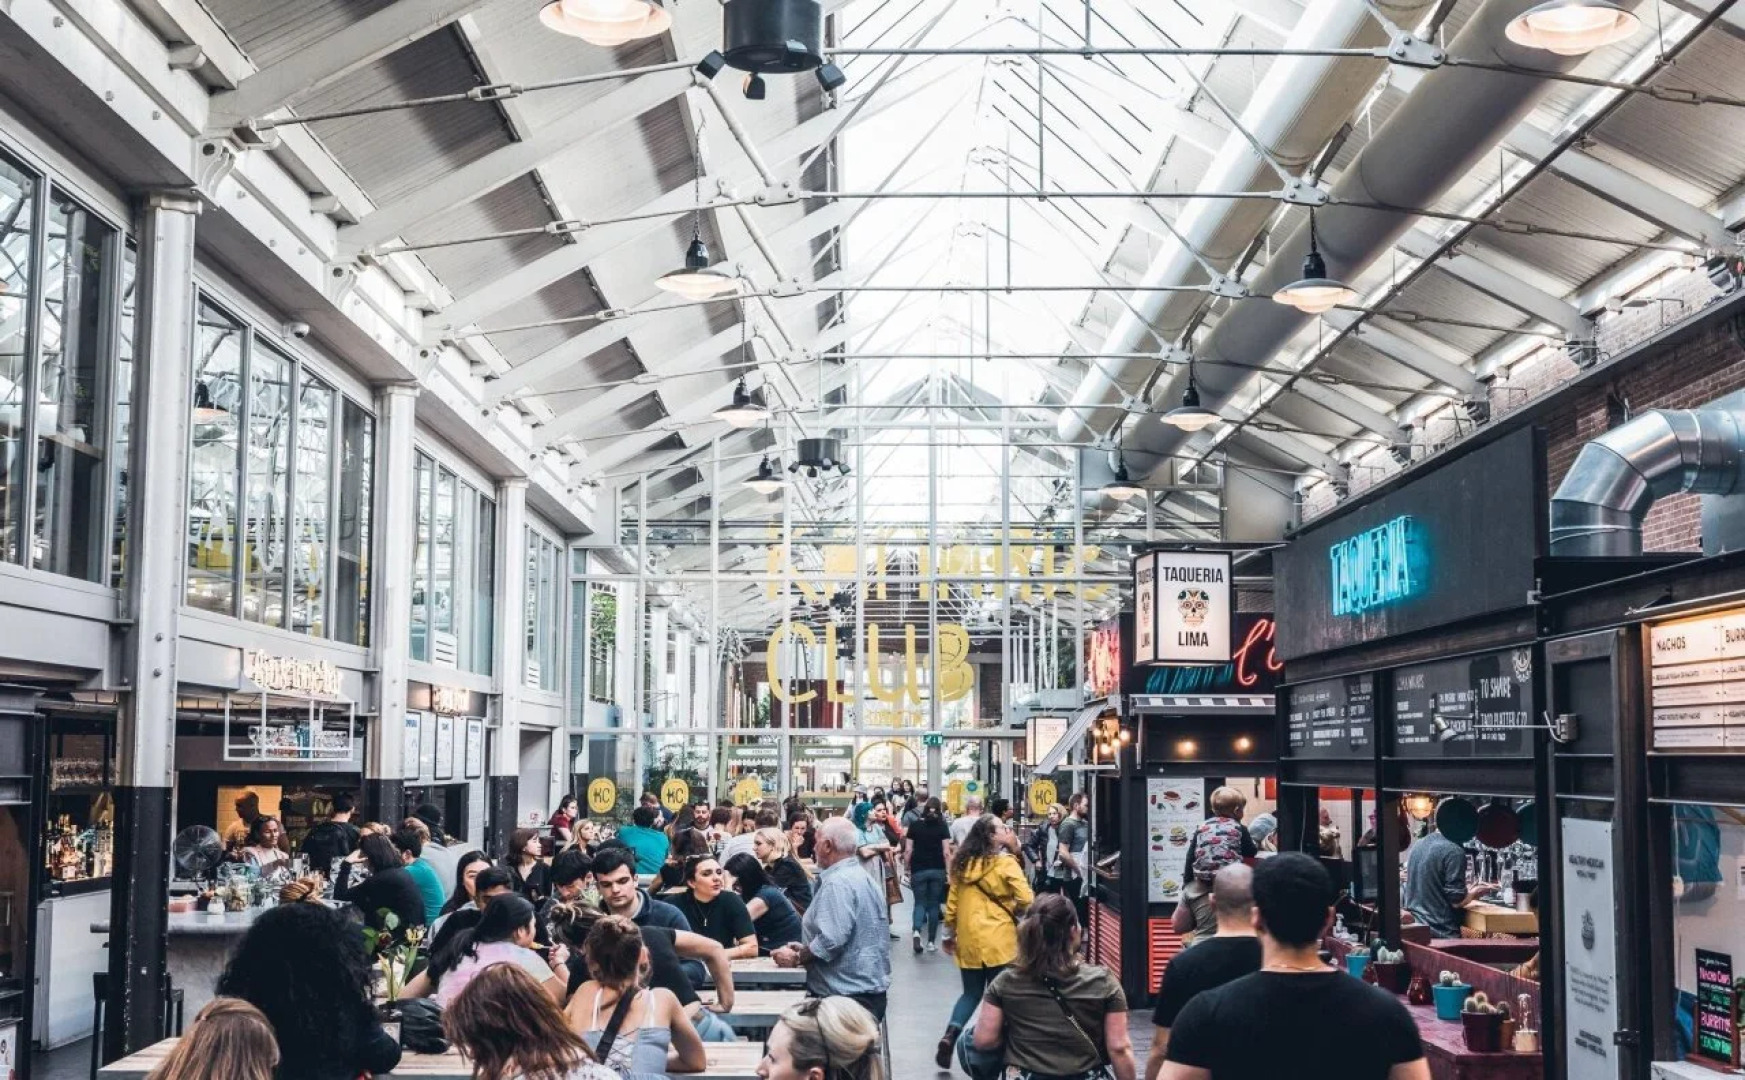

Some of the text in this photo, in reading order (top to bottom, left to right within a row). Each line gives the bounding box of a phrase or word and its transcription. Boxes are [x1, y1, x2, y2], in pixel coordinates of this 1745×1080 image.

[1330, 515, 1410, 616] TAQUERIA
[1163, 566, 1224, 583] TAQUERIA
[1178, 631, 1209, 647] LIMA
[1656, 636, 1686, 652] NACHOS
[766, 621, 975, 705] CLUB
